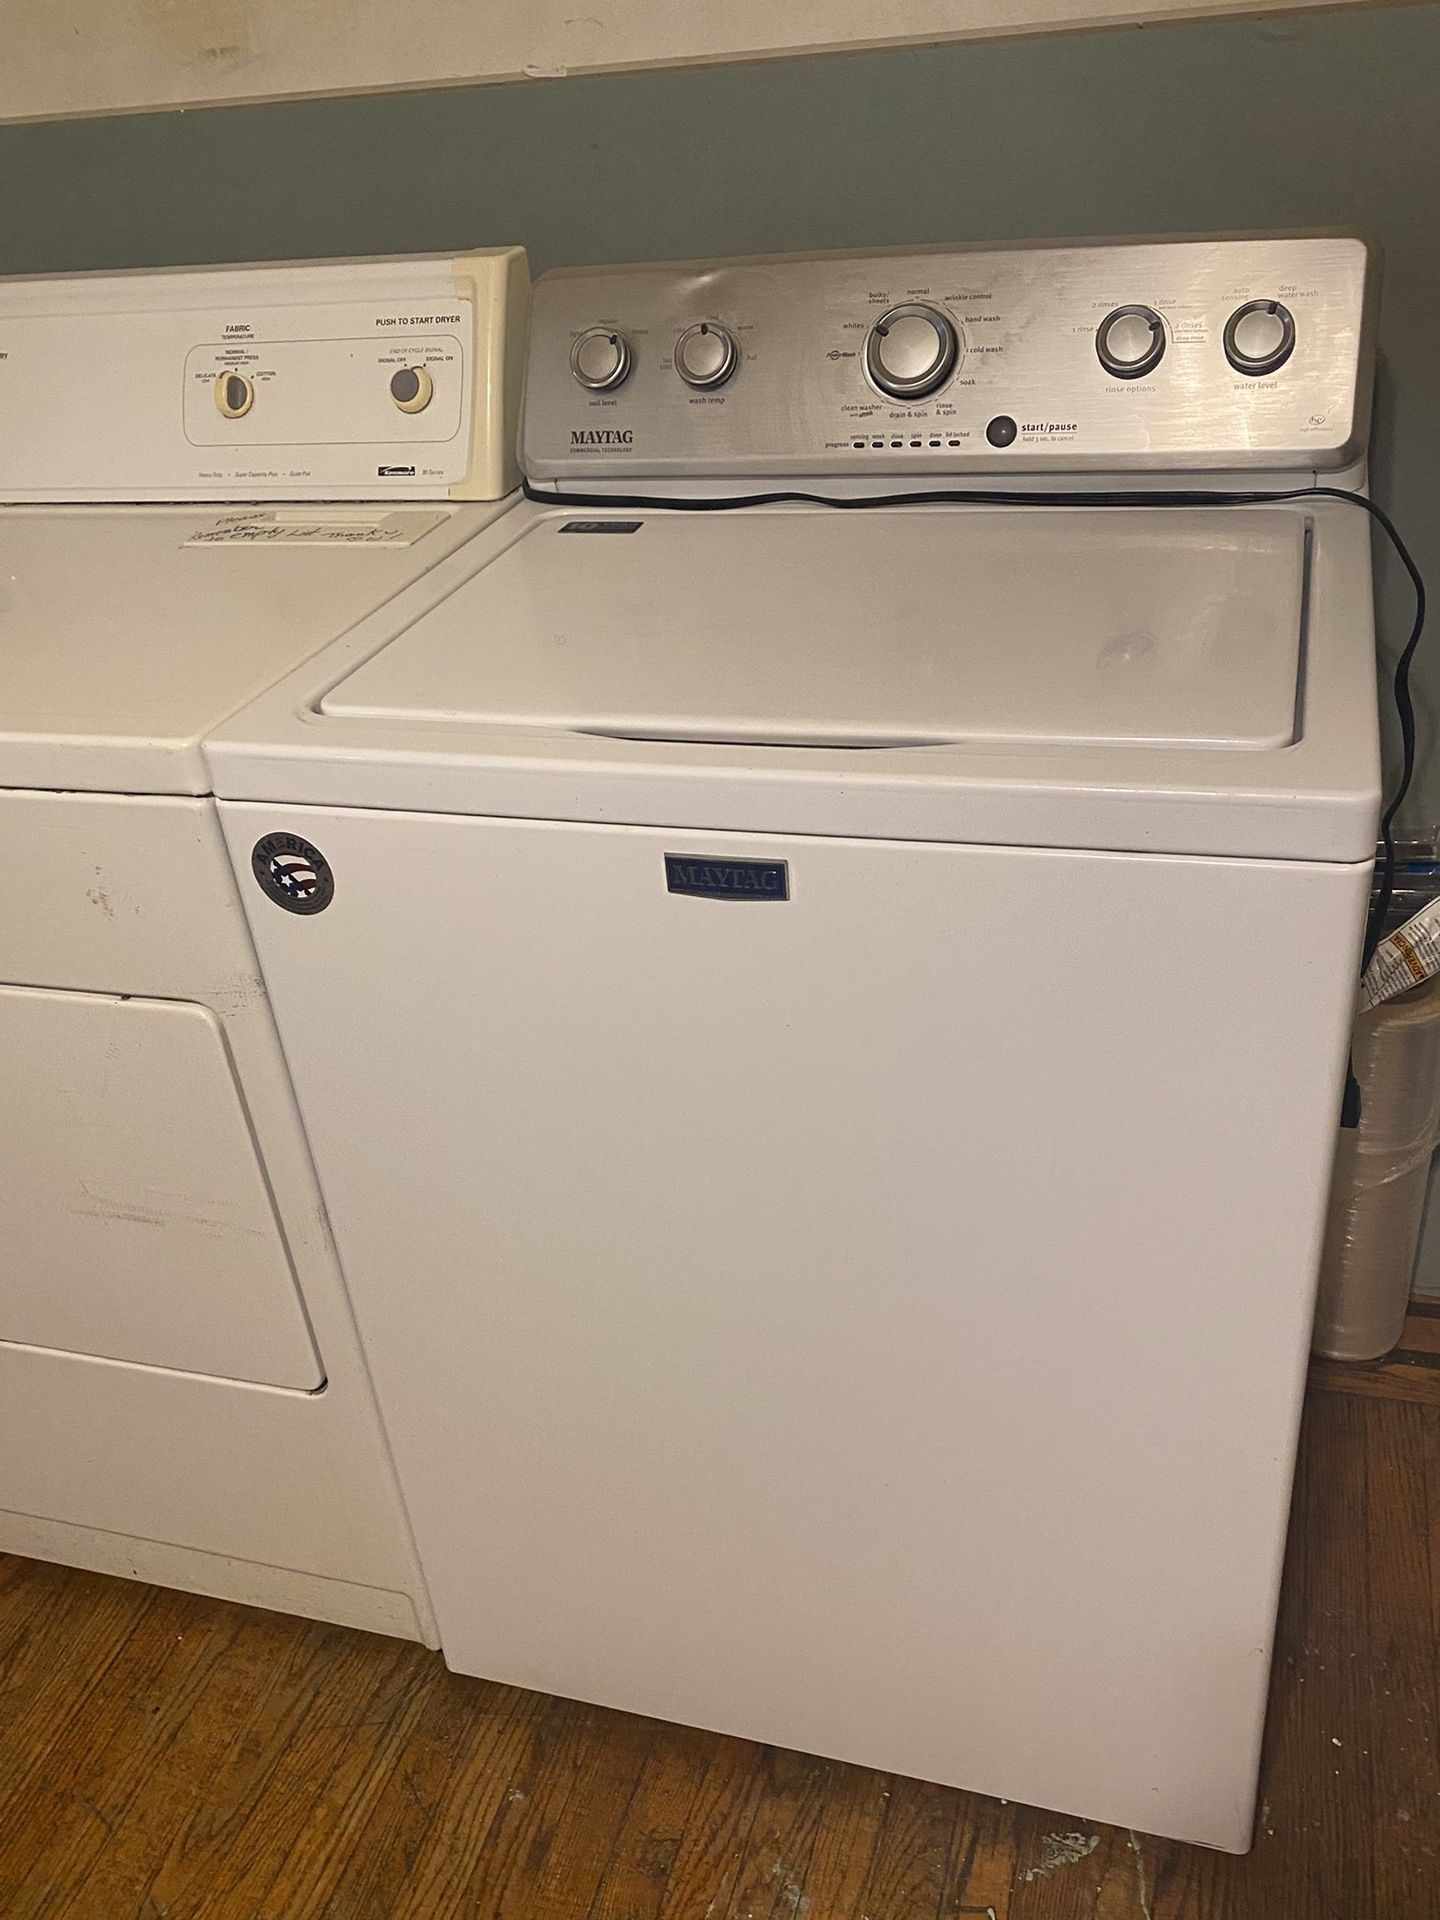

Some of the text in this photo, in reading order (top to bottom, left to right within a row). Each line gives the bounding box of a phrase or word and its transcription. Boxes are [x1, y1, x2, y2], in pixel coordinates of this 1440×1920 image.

[375, 315, 461, 326] PUSH TO START DRYER
[226, 325, 251, 333] FABRIC
[1105, 385, 1156, 394] rinse options
[1233, 381, 1278, 390] water level
[602, 399, 617, 407] level
[708, 397, 725, 405] temp
[913, 411, 928, 419] spin
[1021, 422, 1078, 433] start/pause
[570, 430, 633, 444] MAYTAG
[256, 836, 325, 872] AMERICA
[671, 864, 779, 890] MAYTAG
